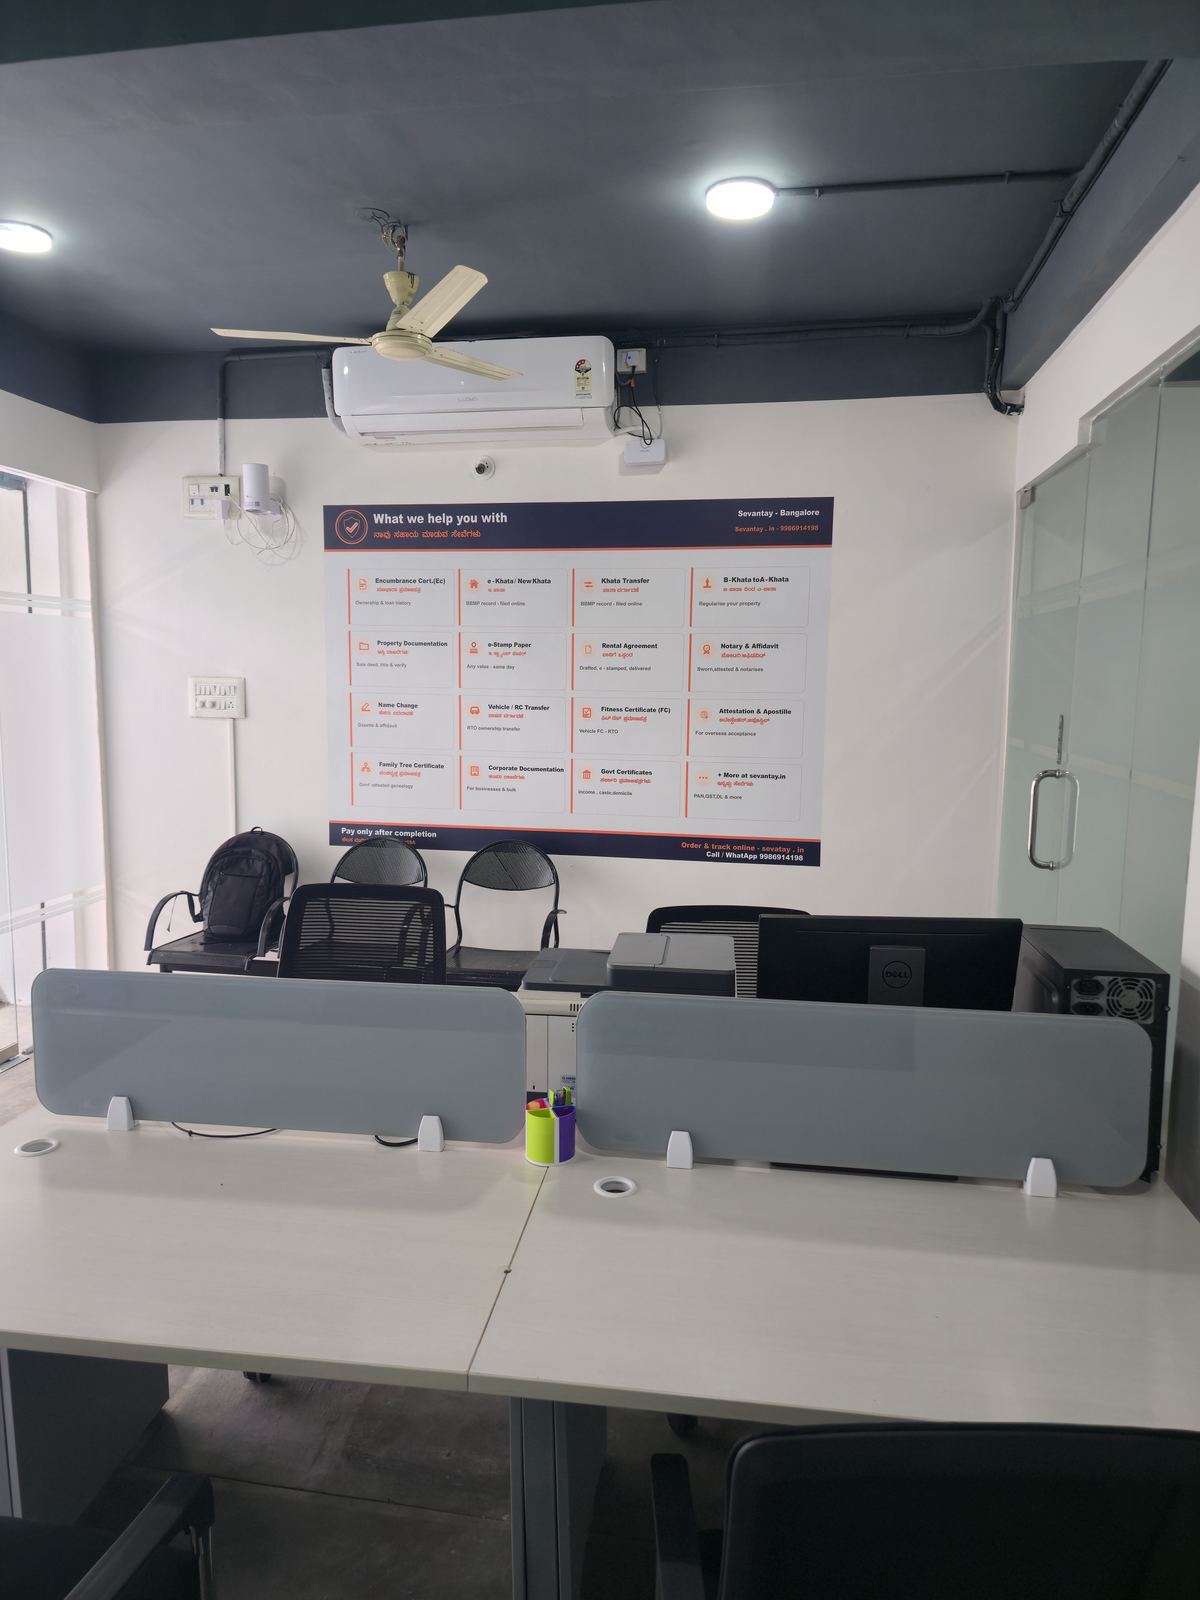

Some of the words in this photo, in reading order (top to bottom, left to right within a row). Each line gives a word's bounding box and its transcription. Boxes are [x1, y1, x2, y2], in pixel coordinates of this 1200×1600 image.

[373, 513, 404, 524] What
[406, 515, 425, 524] we
[427, 512, 453, 525] help
[456, 514, 478, 525] you
[481, 512, 508, 524] with
[737, 509, 773, 519] Sevantay
[780, 508, 820, 517] Bangalore
[488, 641, 513, 649] e-Stamp
[378, 761, 398, 769] Family
[341, 827, 355, 836] Pay
[356, 828, 373, 837] only
[374, 829, 392, 837] after
[394, 830, 437, 839] completion
[711, 843, 731, 851] track
[761, 845, 790, 854] sevatay
[725, 851, 758, 860] WhatApp
[759, 853, 804, 861] 9986914198
